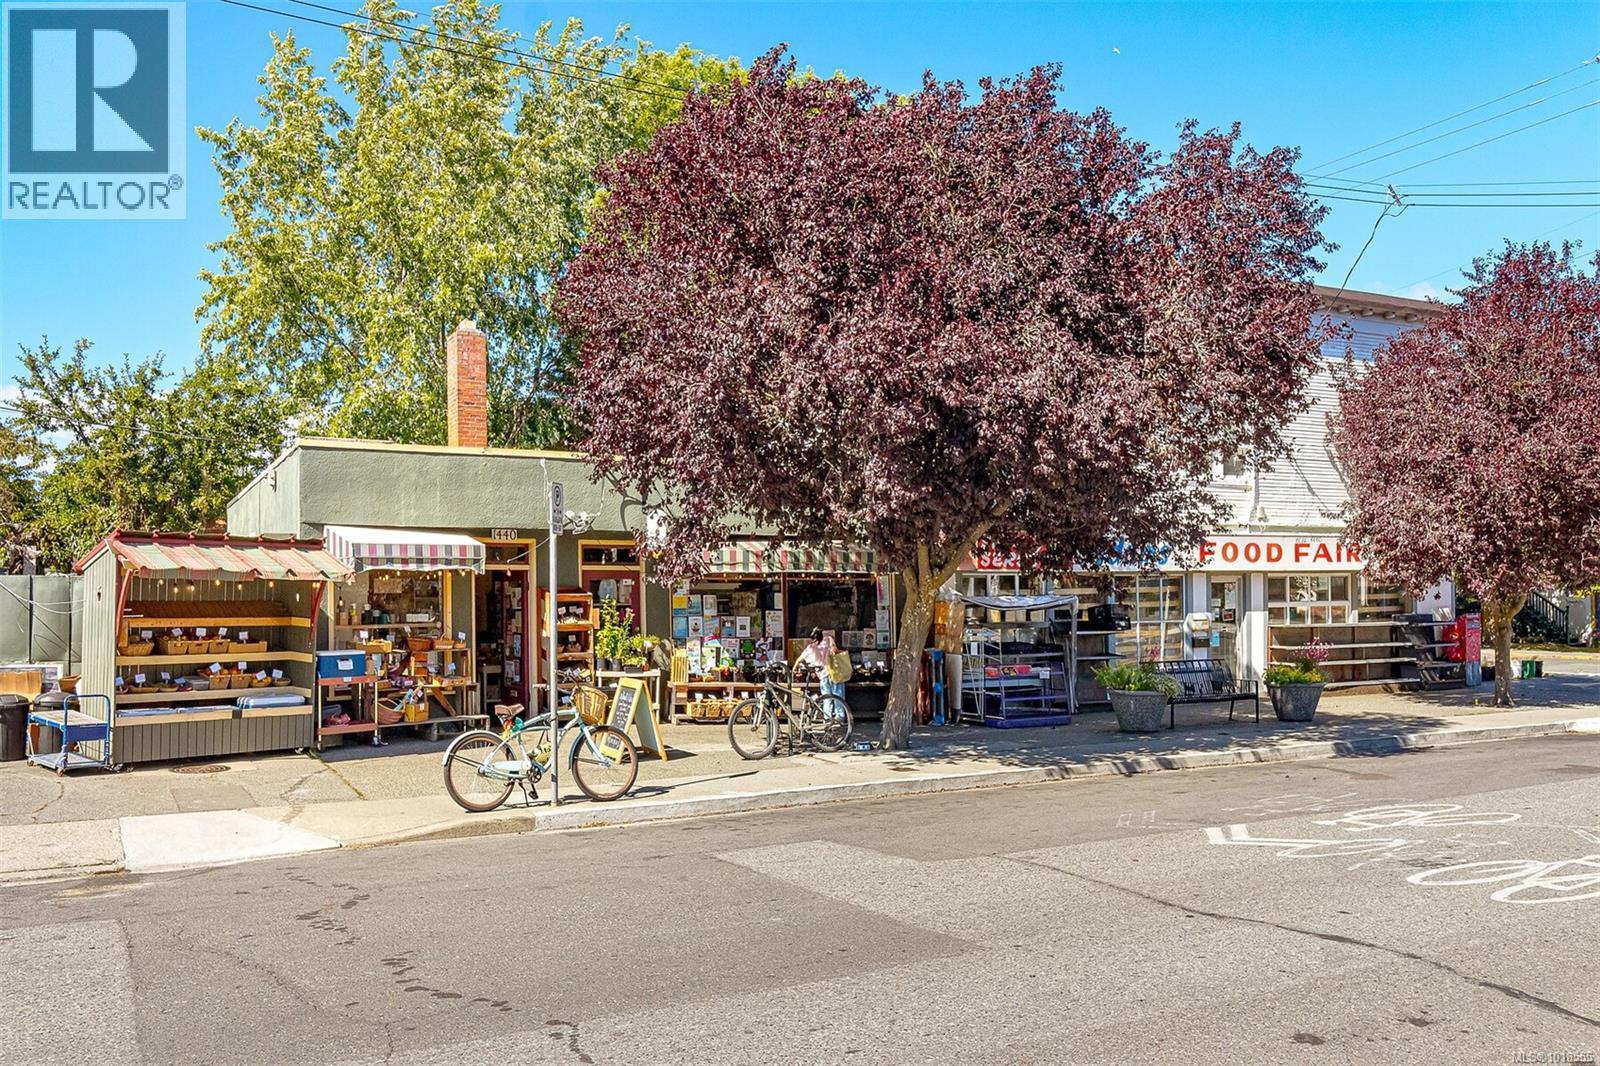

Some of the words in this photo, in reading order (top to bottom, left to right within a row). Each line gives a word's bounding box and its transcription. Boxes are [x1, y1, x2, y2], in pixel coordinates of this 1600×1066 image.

[492, 530, 517, 540] 1440
[1199, 541, 1283, 564] FOOD
[1294, 542, 1361, 563] FAIR
